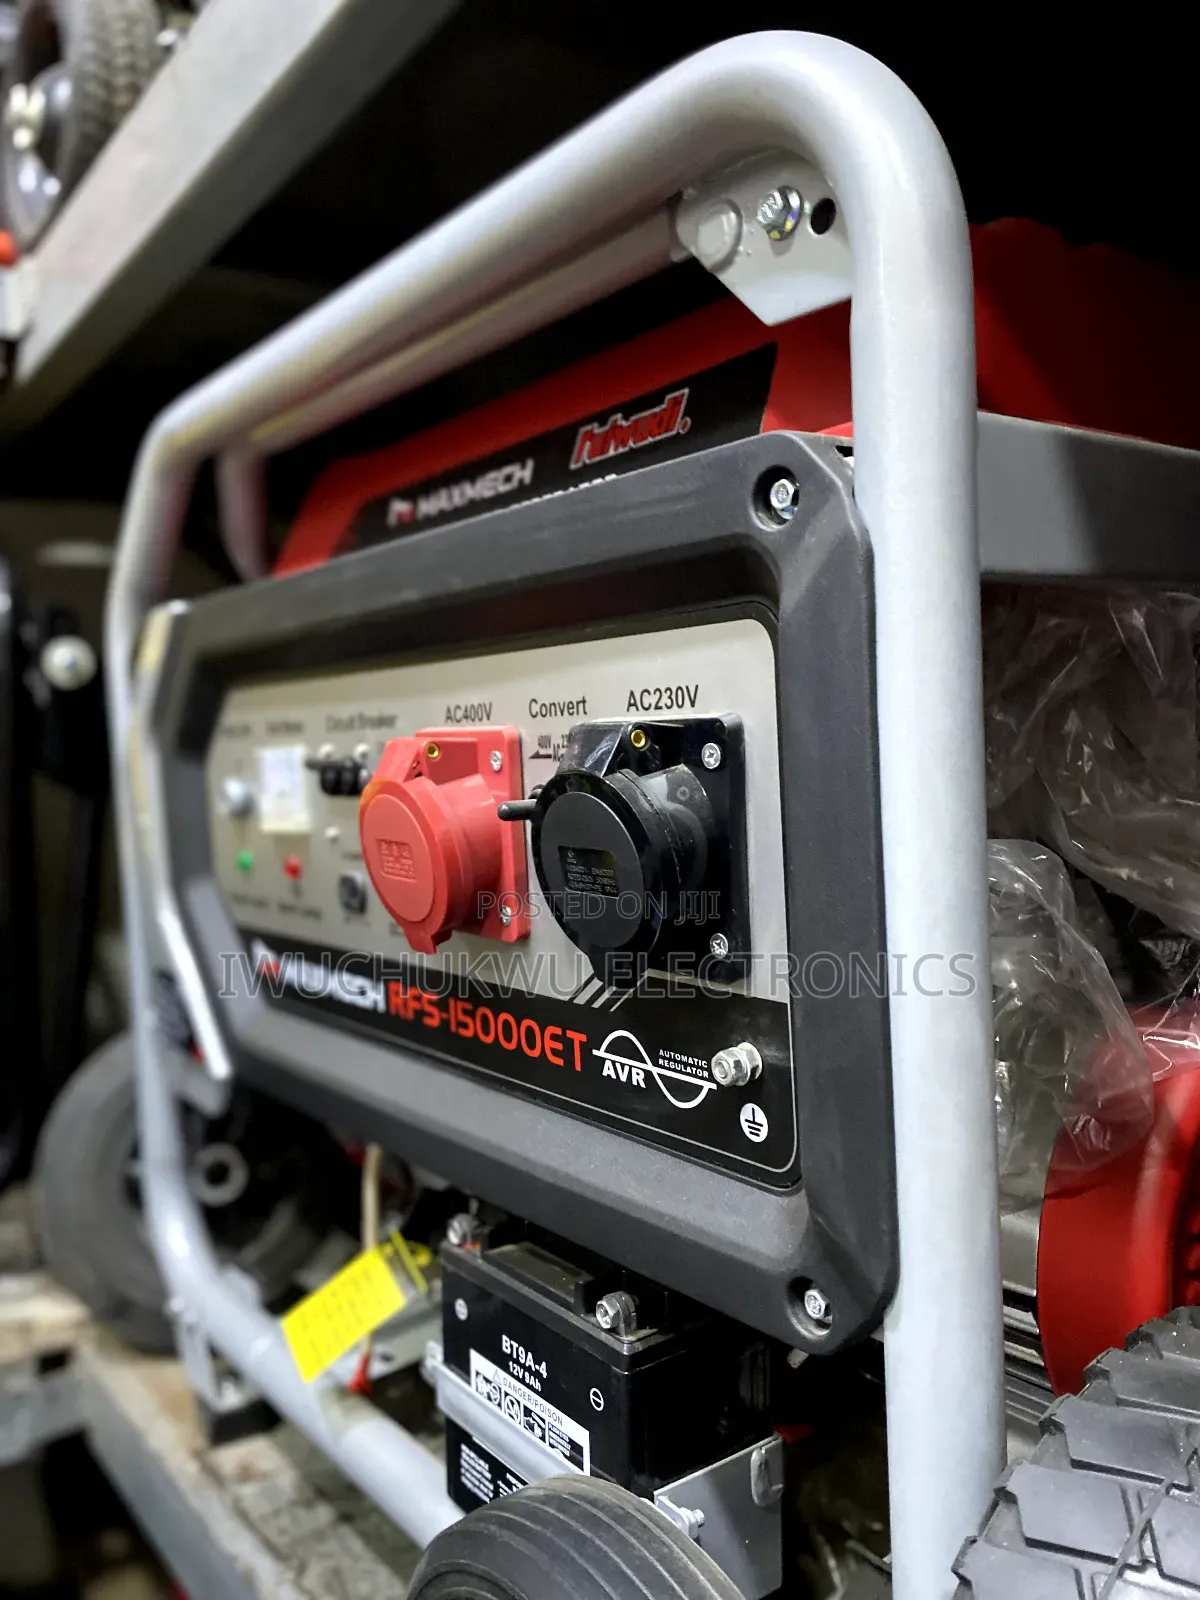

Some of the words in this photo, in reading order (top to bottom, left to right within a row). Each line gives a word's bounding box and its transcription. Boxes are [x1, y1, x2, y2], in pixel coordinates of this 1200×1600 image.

[444, 702, 493, 723] AC400V
[528, 696, 588, 719] Convert
[626, 684, 699, 712] AC230V
[387, 980, 588, 1072] RFS-15000ET
[658, 1049, 708, 1068] AUTOMATIC
[658, 1058, 709, 1078] REGULATOR
[602, 1059, 647, 1089] AVR
[502, 1334, 548, 1379] BT9A-4
[508, 1361, 524, 1379] 12V
[524, 1371, 542, 1392] 9Ah
[502, 1377, 563, 1427] DANGER/POISON
